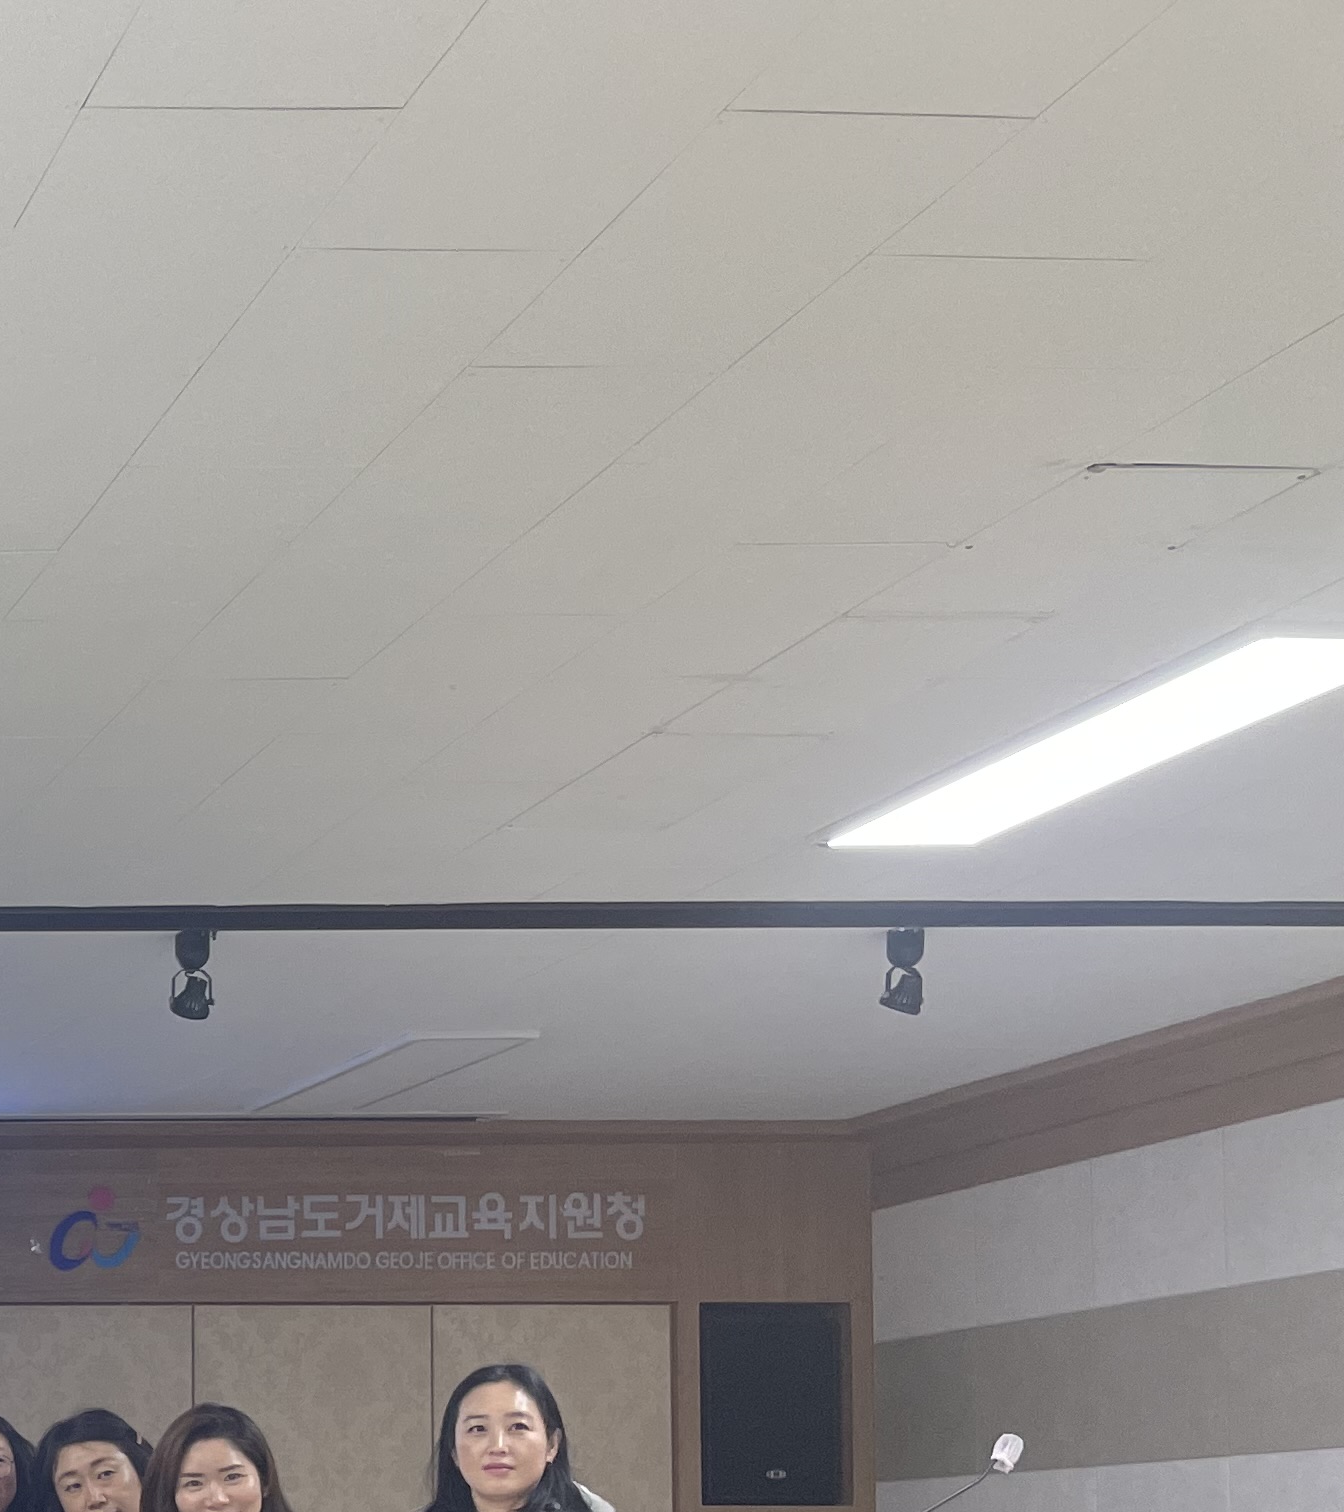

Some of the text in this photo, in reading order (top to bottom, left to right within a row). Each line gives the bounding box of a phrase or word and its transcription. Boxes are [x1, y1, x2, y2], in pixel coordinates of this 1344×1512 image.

[165, 1192, 645, 1243] 경상남도거제교육지원청
[175, 1251, 633, 1270] GYEONGSANGNAMDO GEOJE OFFICE OF EDUCATION
